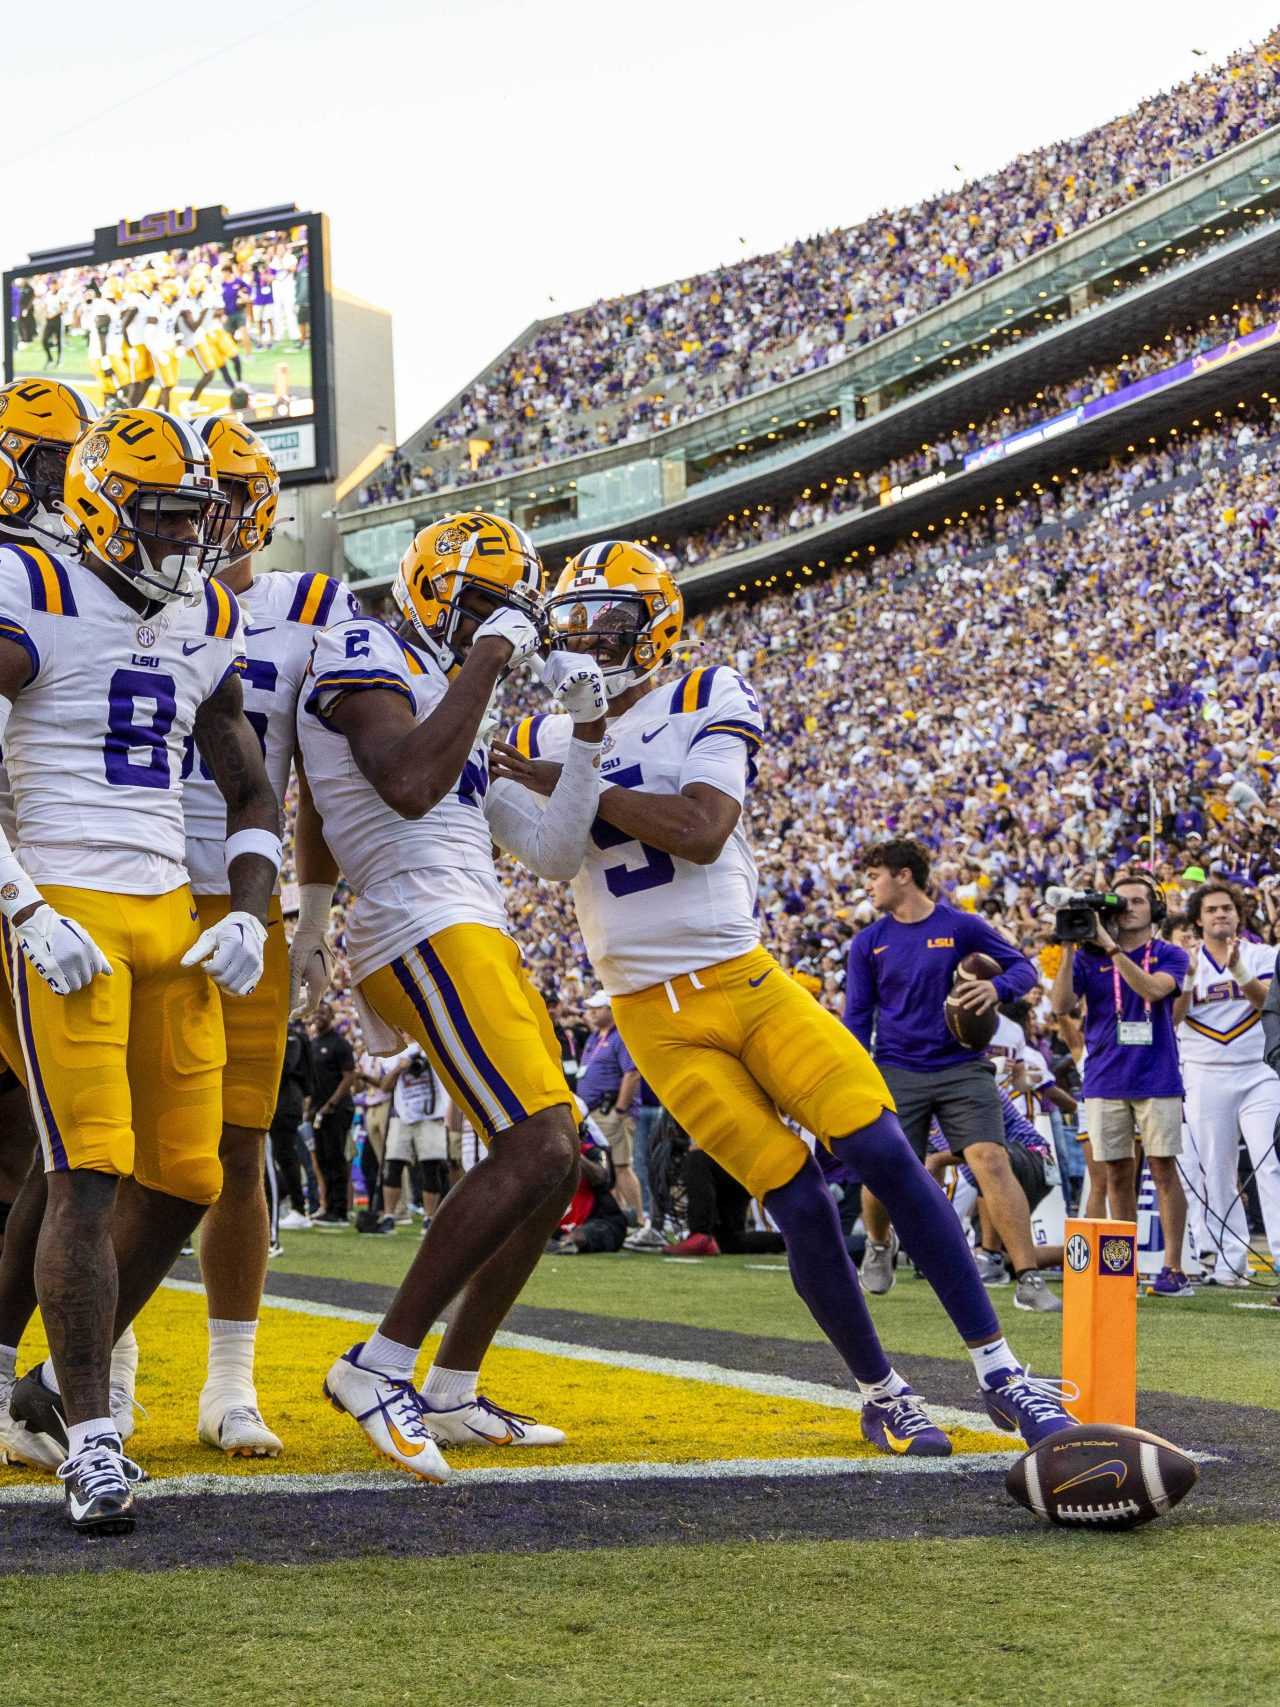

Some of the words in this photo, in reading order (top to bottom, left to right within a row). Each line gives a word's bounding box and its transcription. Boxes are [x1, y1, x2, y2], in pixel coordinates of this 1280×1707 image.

[117, 206, 196, 247] LSU
[94, 413, 155, 446] SU
[137, 626, 156, 648] SEC
[343, 629, 370, 659] 2
[131, 654, 161, 668] LSU
[102, 668, 177, 790] 8
[927, 937, 955, 949] LSU
[1067, 1234, 1089, 1269] SEC
